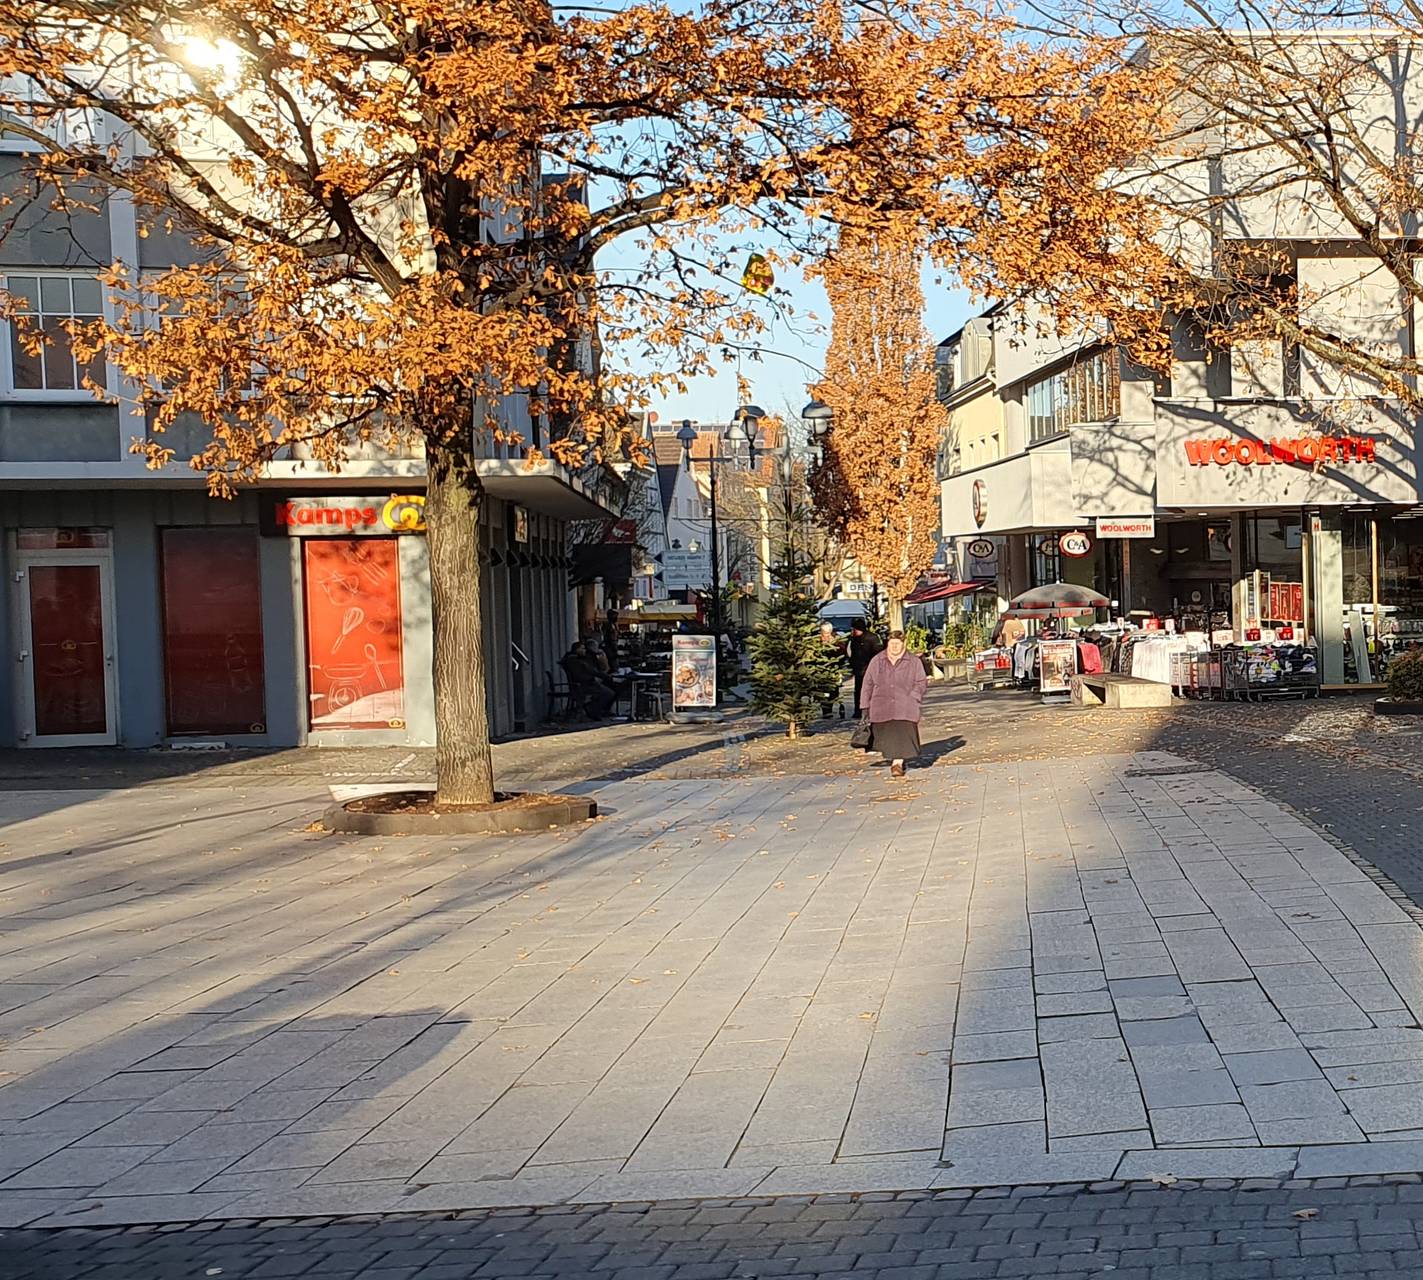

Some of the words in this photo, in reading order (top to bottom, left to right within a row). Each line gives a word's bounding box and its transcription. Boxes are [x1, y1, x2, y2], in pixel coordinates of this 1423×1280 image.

[1184, 436, 1376, 466] WOOLWORTH
[275, 501, 378, 530] Kamps
[1099, 524, 1152, 532] WOOLWORTH
[1067, 538, 1087, 550] C&A
